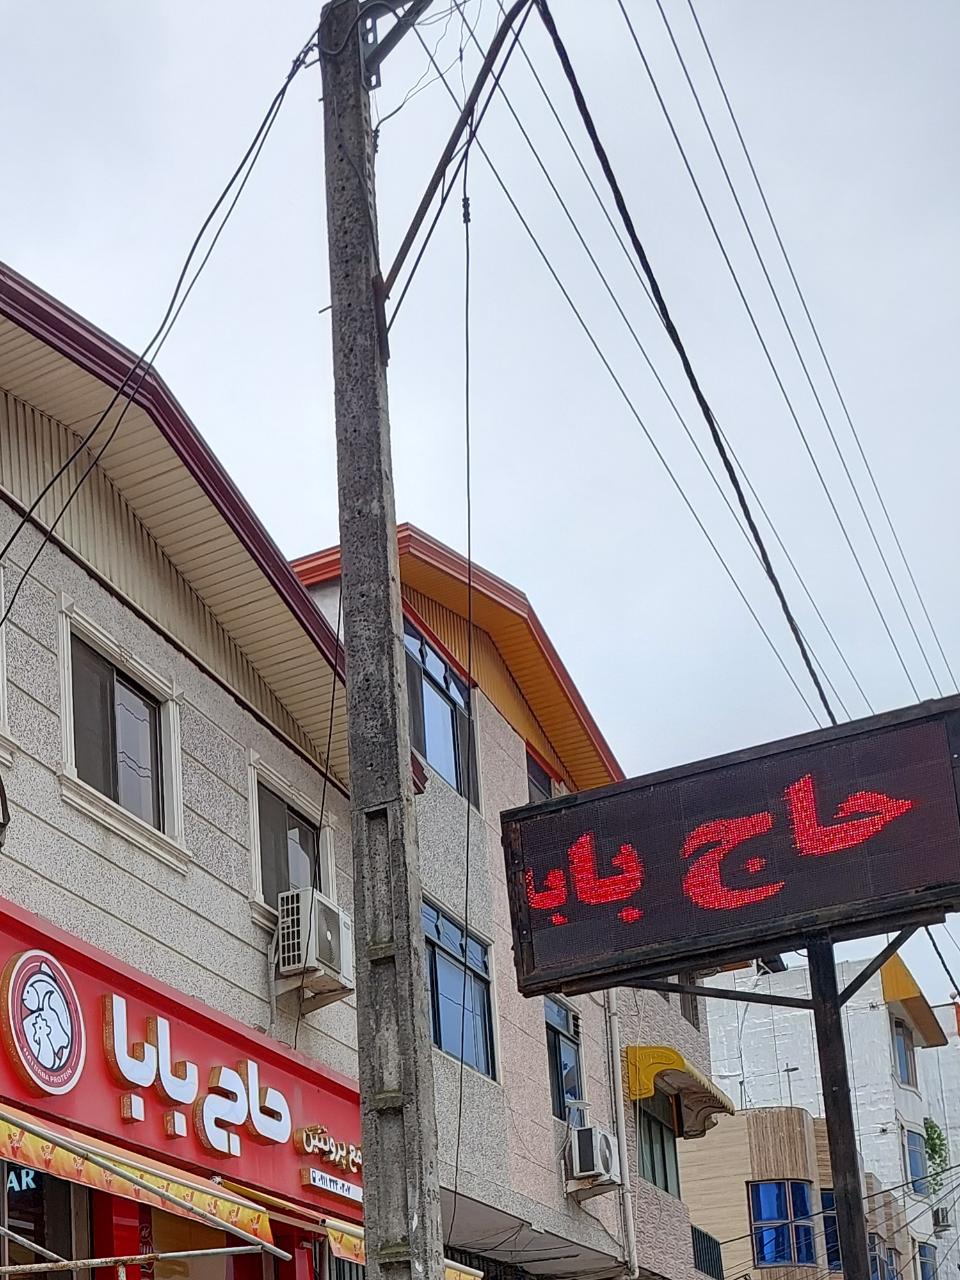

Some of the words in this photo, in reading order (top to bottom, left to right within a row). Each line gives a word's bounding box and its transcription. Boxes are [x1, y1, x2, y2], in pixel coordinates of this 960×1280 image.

[681, 773, 914, 911] حاج
[49, 1067, 73, 1084] PROTEIN
[105, 993, 200, 1137] بابا
[195, 1060, 292, 1157] حاج
